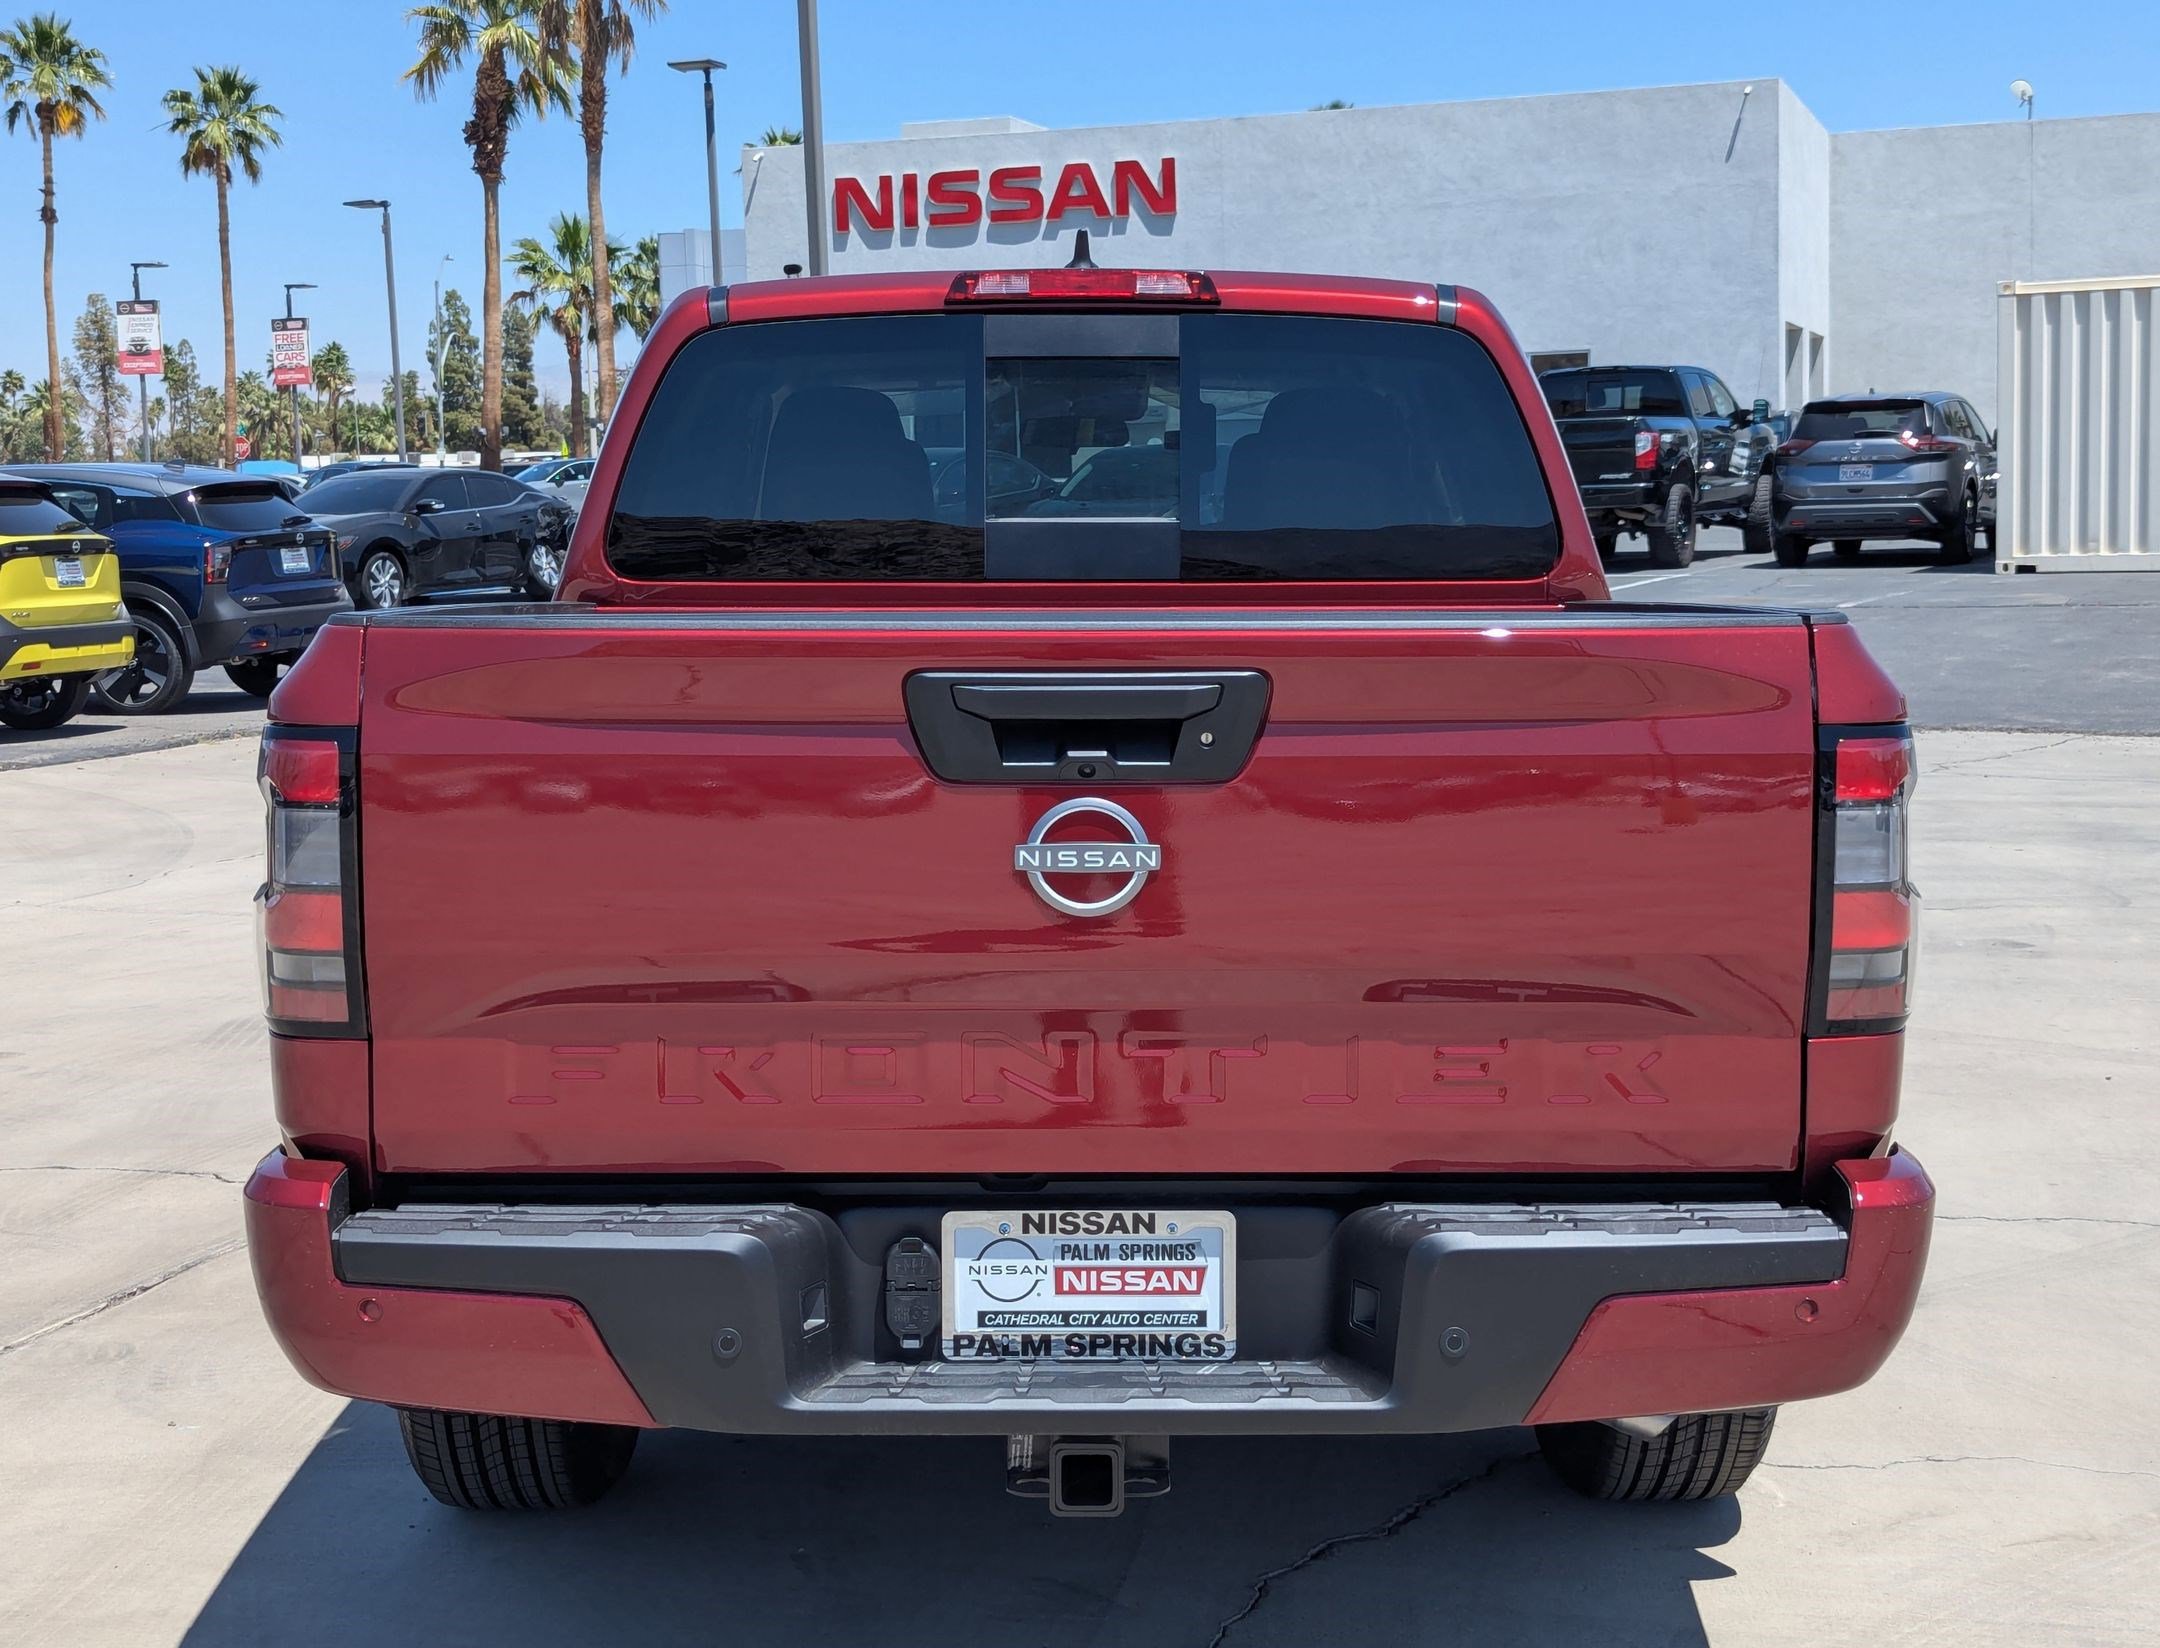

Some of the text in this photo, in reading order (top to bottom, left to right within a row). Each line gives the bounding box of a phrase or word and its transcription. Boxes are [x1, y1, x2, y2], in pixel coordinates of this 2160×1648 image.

[834, 157, 1177, 234] NISSAN
[274, 332, 305, 344] FREE
[275, 352, 306, 362] CARS
[1019, 850, 1157, 868] NISSAN
[507, 1030, 1670, 1105] FRONTIER
[1021, 1211, 1157, 1235] NISSAN
[1060, 1242, 1197, 1262] PALM SPRINGS
[967, 1264, 1049, 1276] NISSAN
[1062, 1269, 1199, 1292] NISSAN
[984, 1313, 1199, 1326] CATHEDRAL CITY AUTO CENTER
[952, 1332, 1227, 1359] PALM SPRINGS
